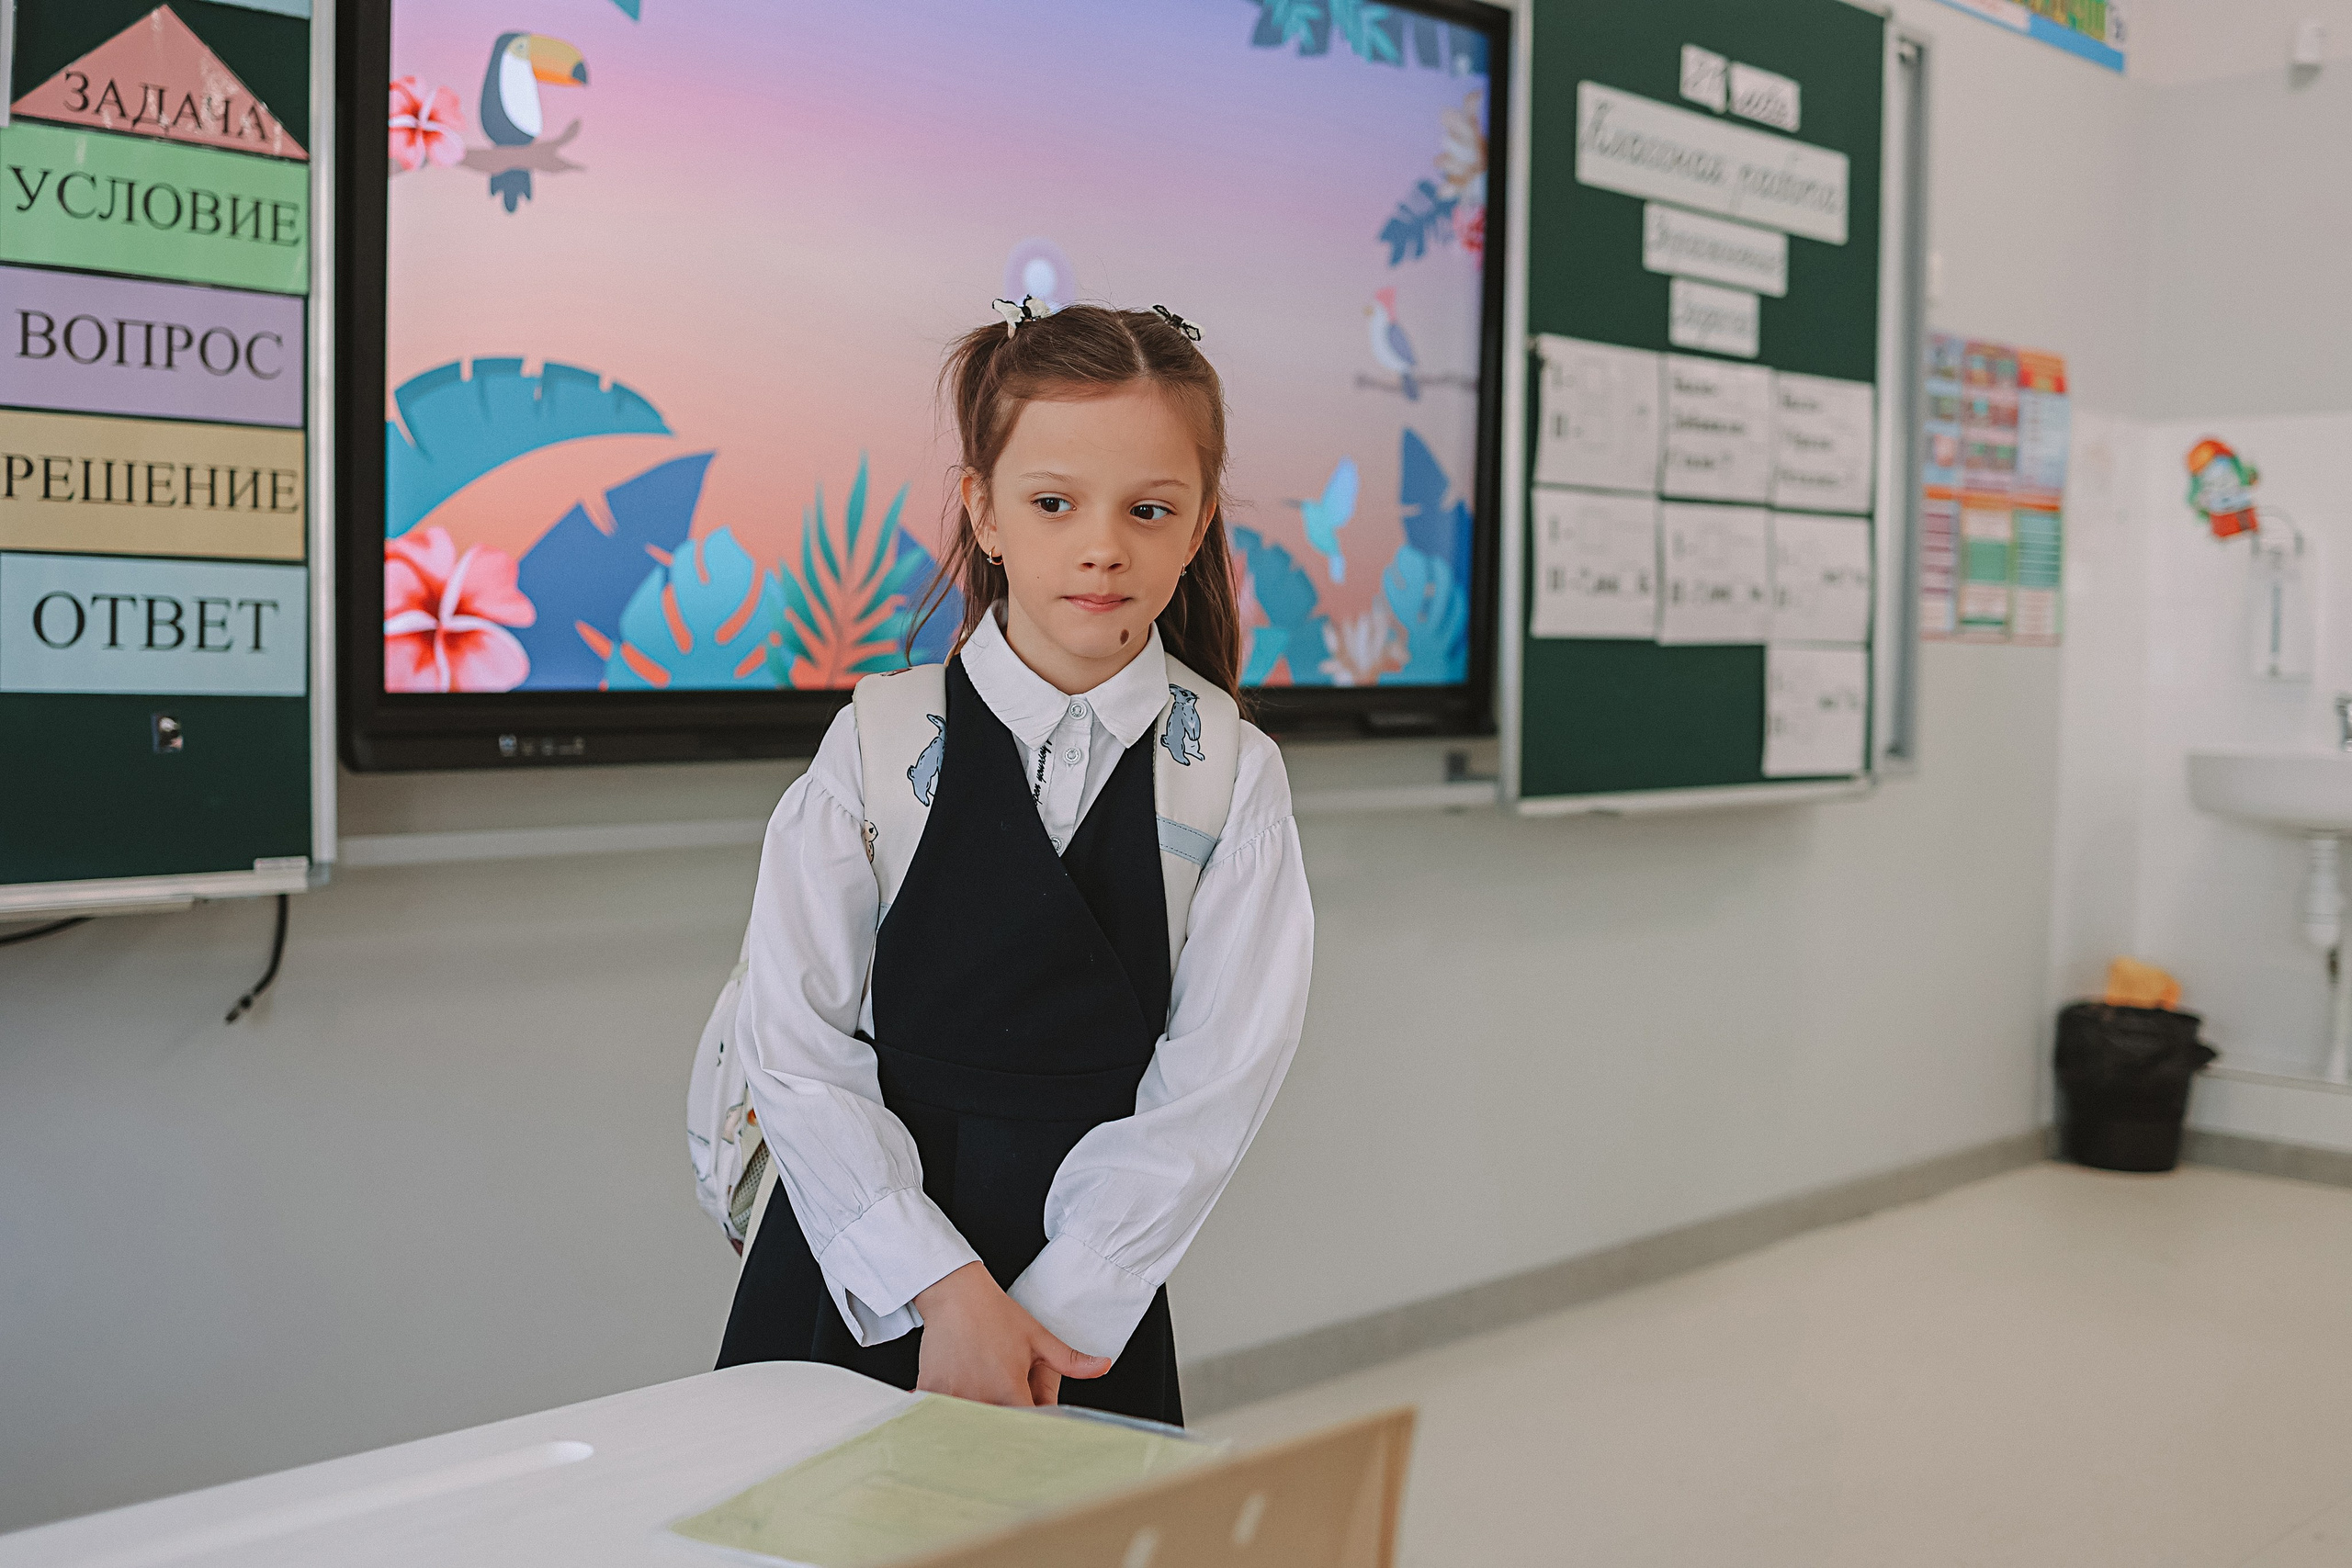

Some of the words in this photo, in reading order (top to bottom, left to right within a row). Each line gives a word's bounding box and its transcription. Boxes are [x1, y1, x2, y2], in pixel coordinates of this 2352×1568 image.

[63, 70, 270, 141] ЗАДАЧА
[7, 164, 301, 247] УСЛОВИЕ
[15, 309, 283, 380] ВОПРОС
[0, 453, 300, 513] РЕШЕНИЕ
[32, 590, 279, 654] ОТВЕТ
